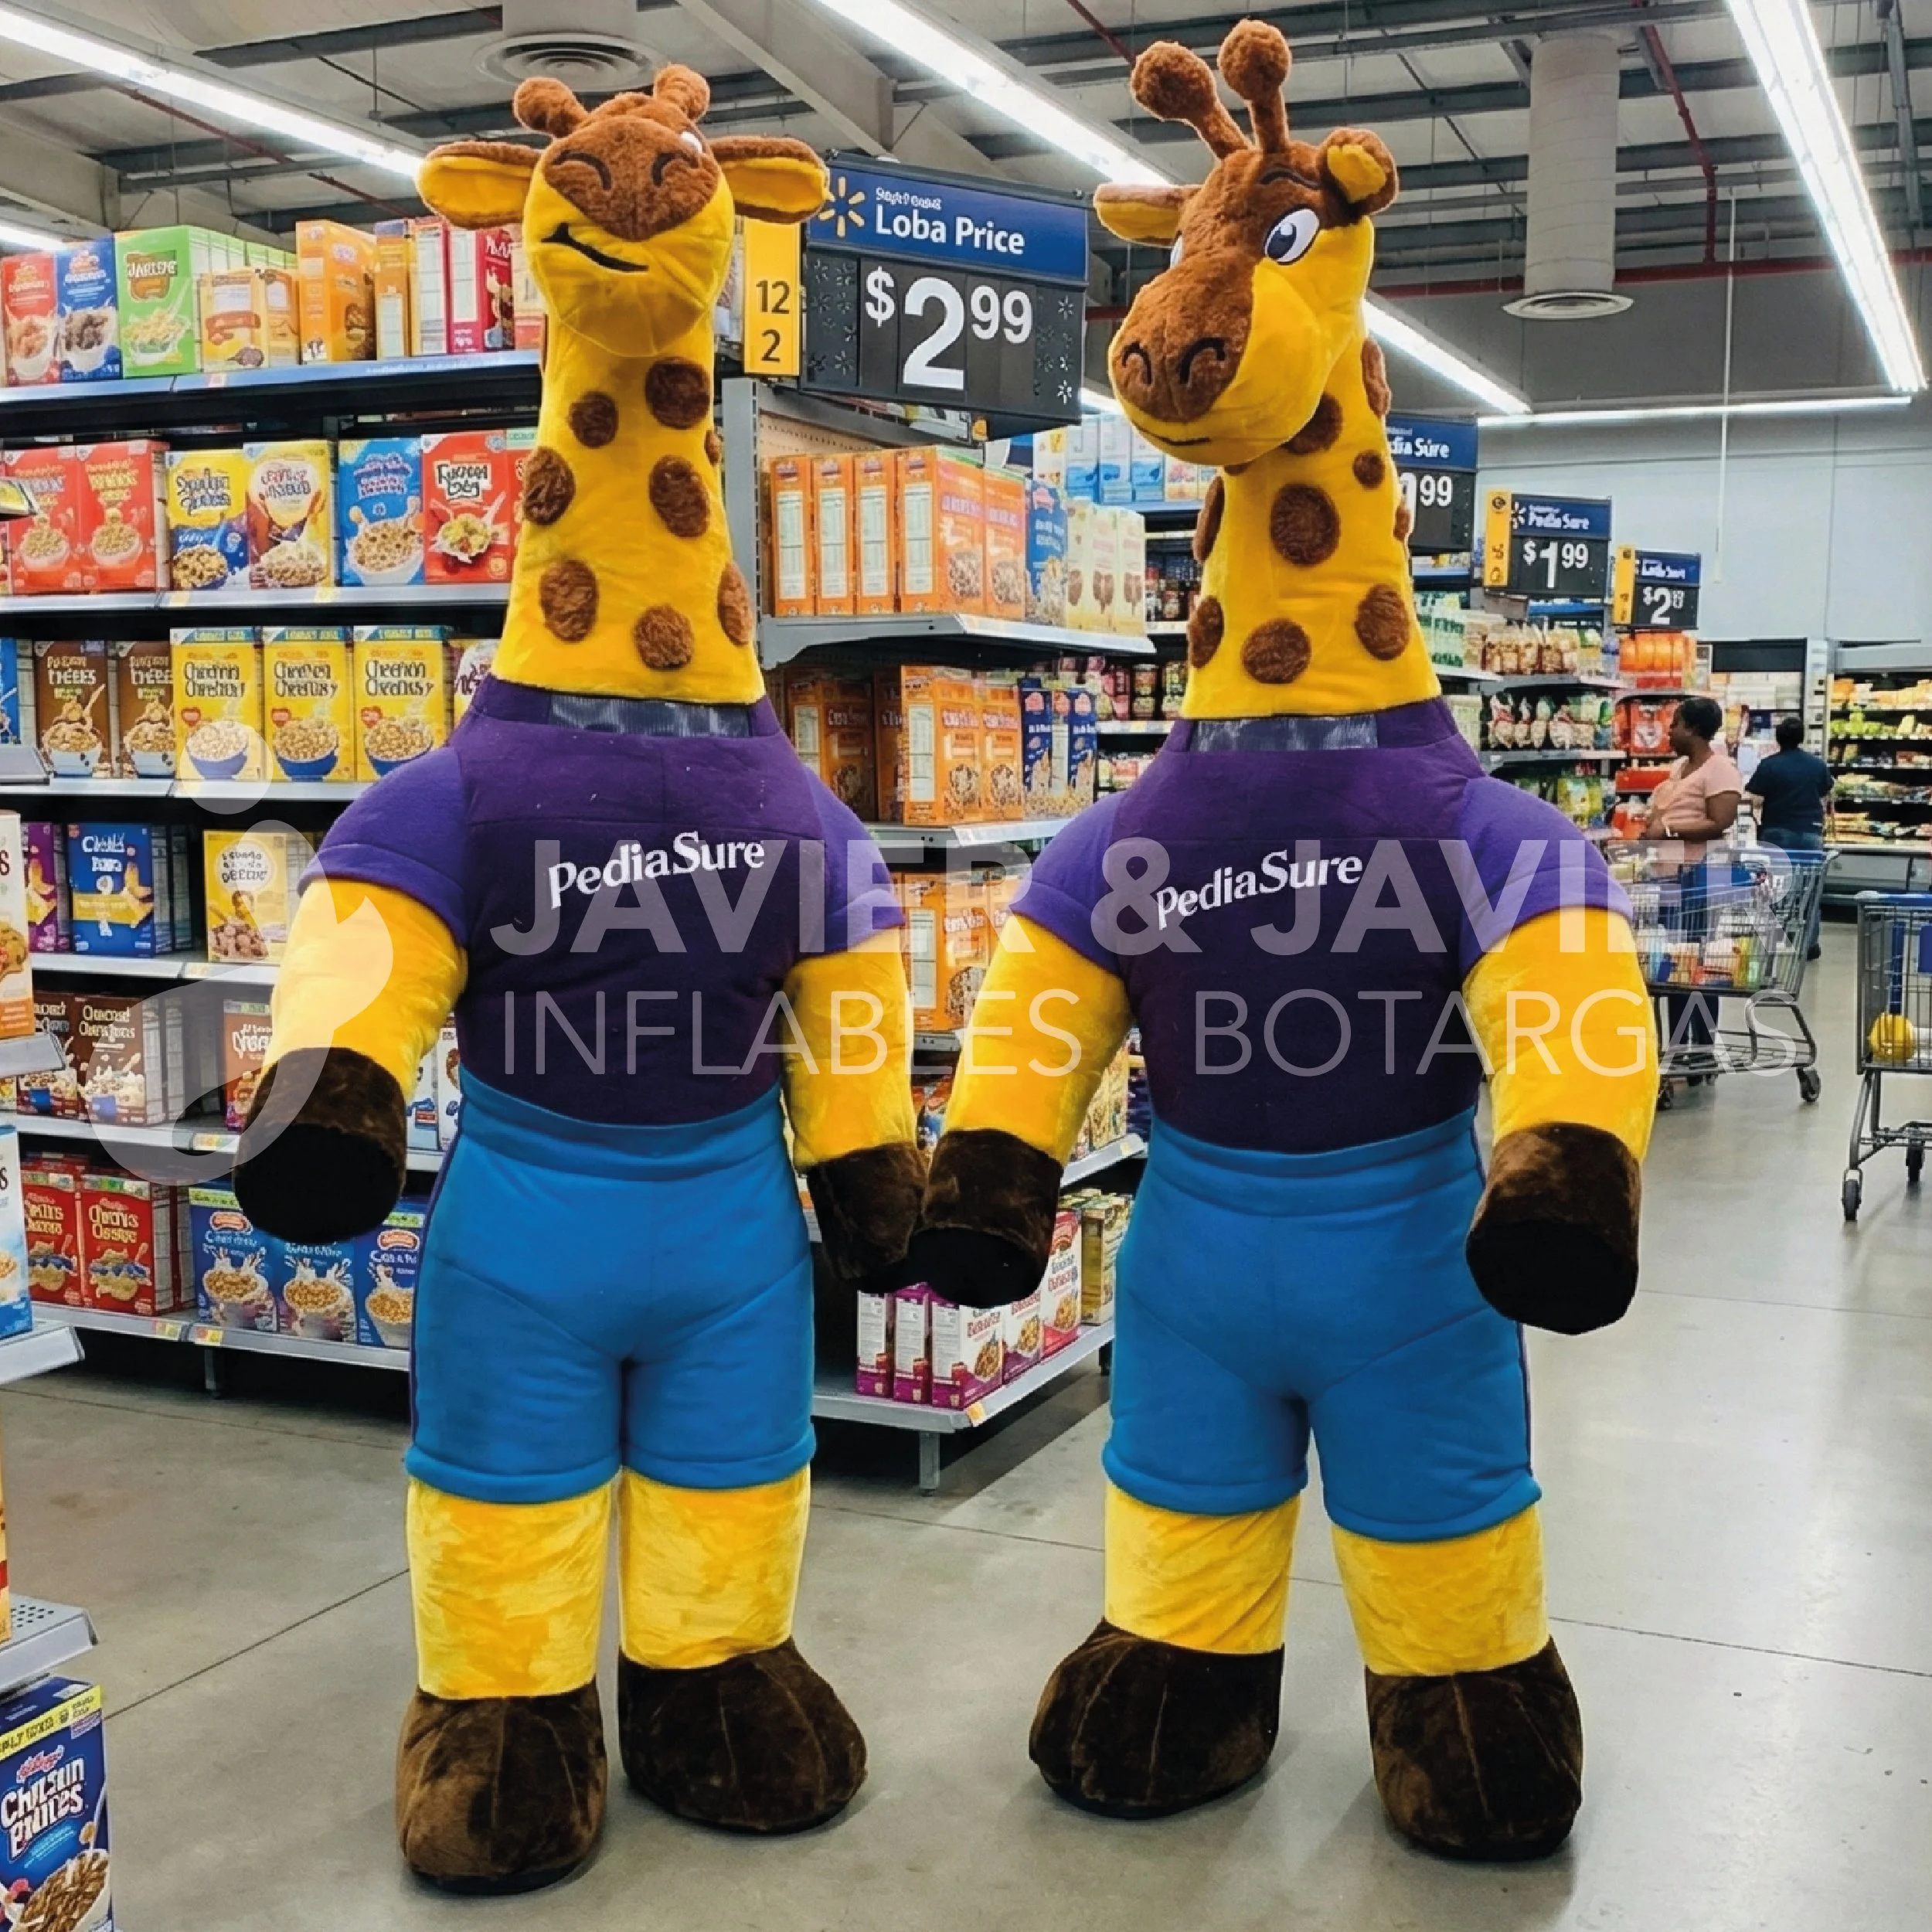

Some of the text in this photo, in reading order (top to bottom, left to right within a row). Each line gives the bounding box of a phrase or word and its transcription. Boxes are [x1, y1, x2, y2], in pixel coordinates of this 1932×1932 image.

[876, 204, 1026, 255] Loba Price
[756, 280, 791, 315] 12
[761, 329, 781, 363] 2
[548, 831, 765, 910] PediaSure
[1156, 849, 1363, 930] PediaSure
